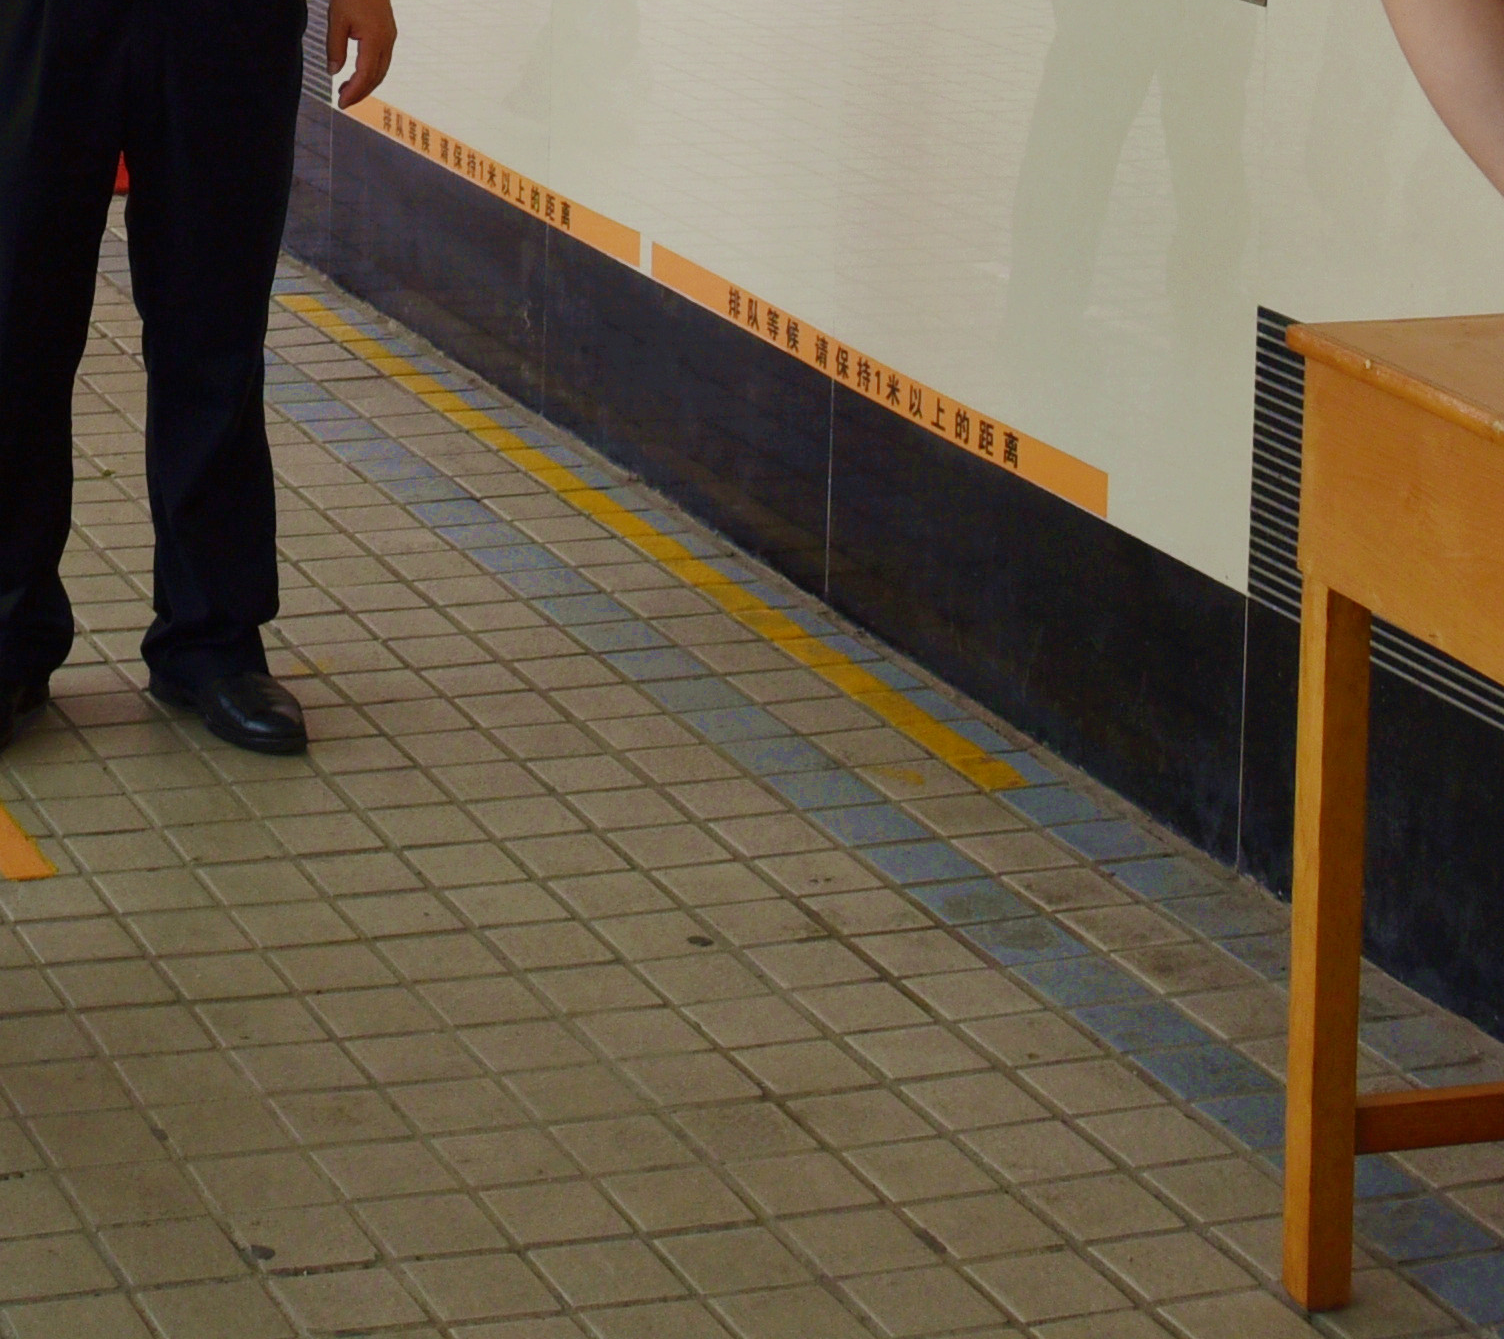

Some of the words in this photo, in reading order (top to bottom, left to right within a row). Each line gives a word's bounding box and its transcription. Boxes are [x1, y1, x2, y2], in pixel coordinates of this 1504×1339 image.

[382, 106, 431, 154] 排队等候
[439, 137, 572, 231] 请保持1米以上的距离
[727, 285, 800, 354] 排队等候
[814, 335, 1020, 469] 请保持1米以上的距离
